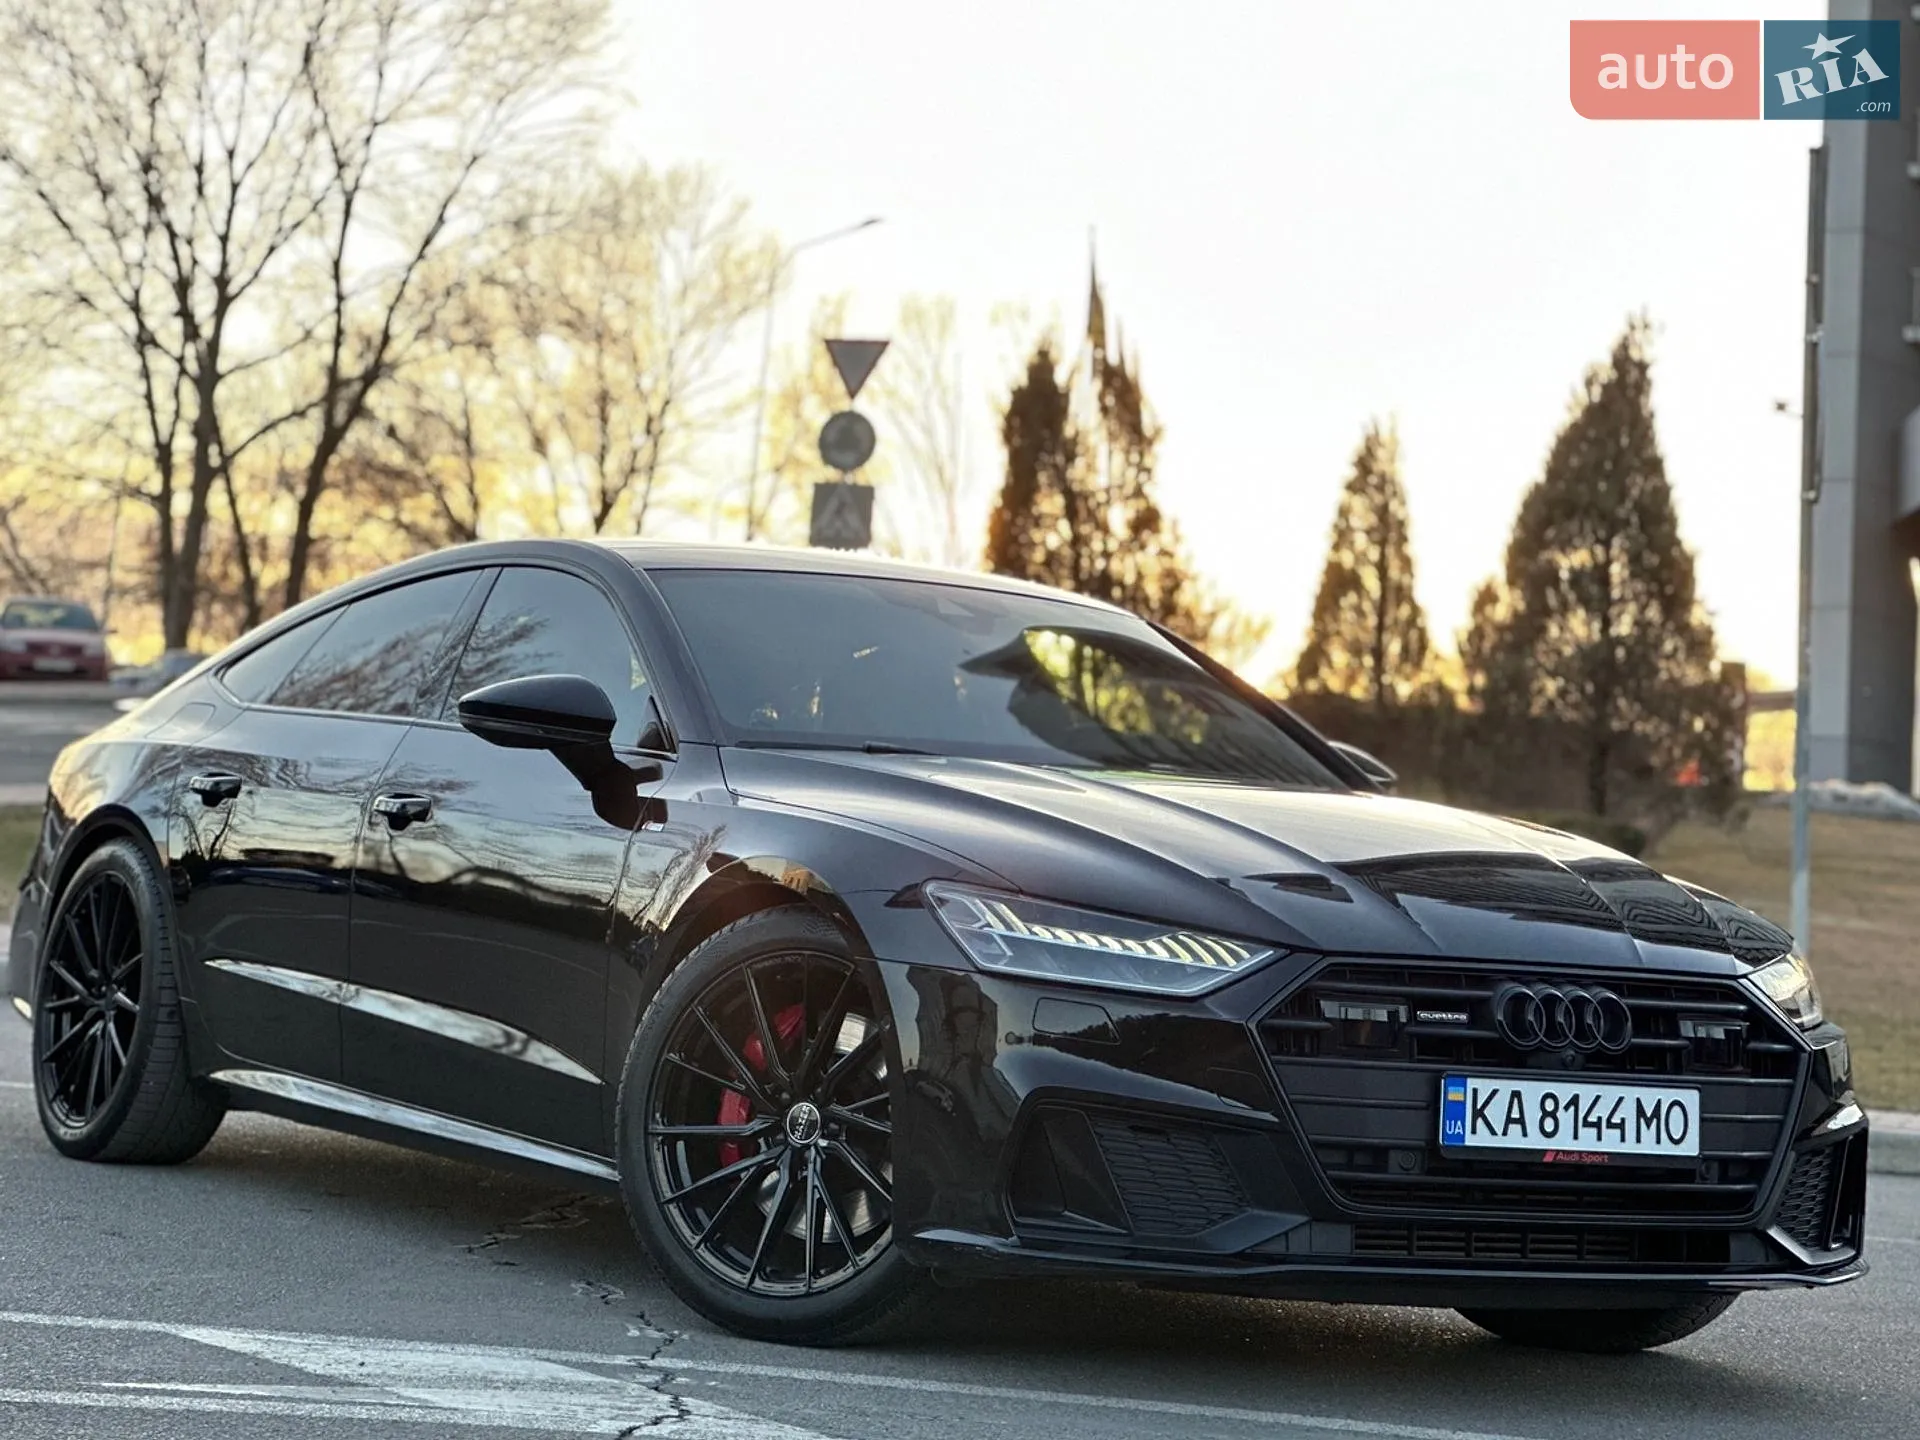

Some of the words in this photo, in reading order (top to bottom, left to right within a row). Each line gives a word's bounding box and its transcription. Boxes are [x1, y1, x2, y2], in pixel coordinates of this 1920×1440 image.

[1470, 1087, 1528, 1138] KA
[1538, 1092, 1626, 1143] 8144
[1635, 1097, 1689, 1145] MO
[1446, 1119, 1464, 1135] UA
[1556, 1152, 1580, 1161] Audi
[1581, 1152, 1609, 1163] Sport
